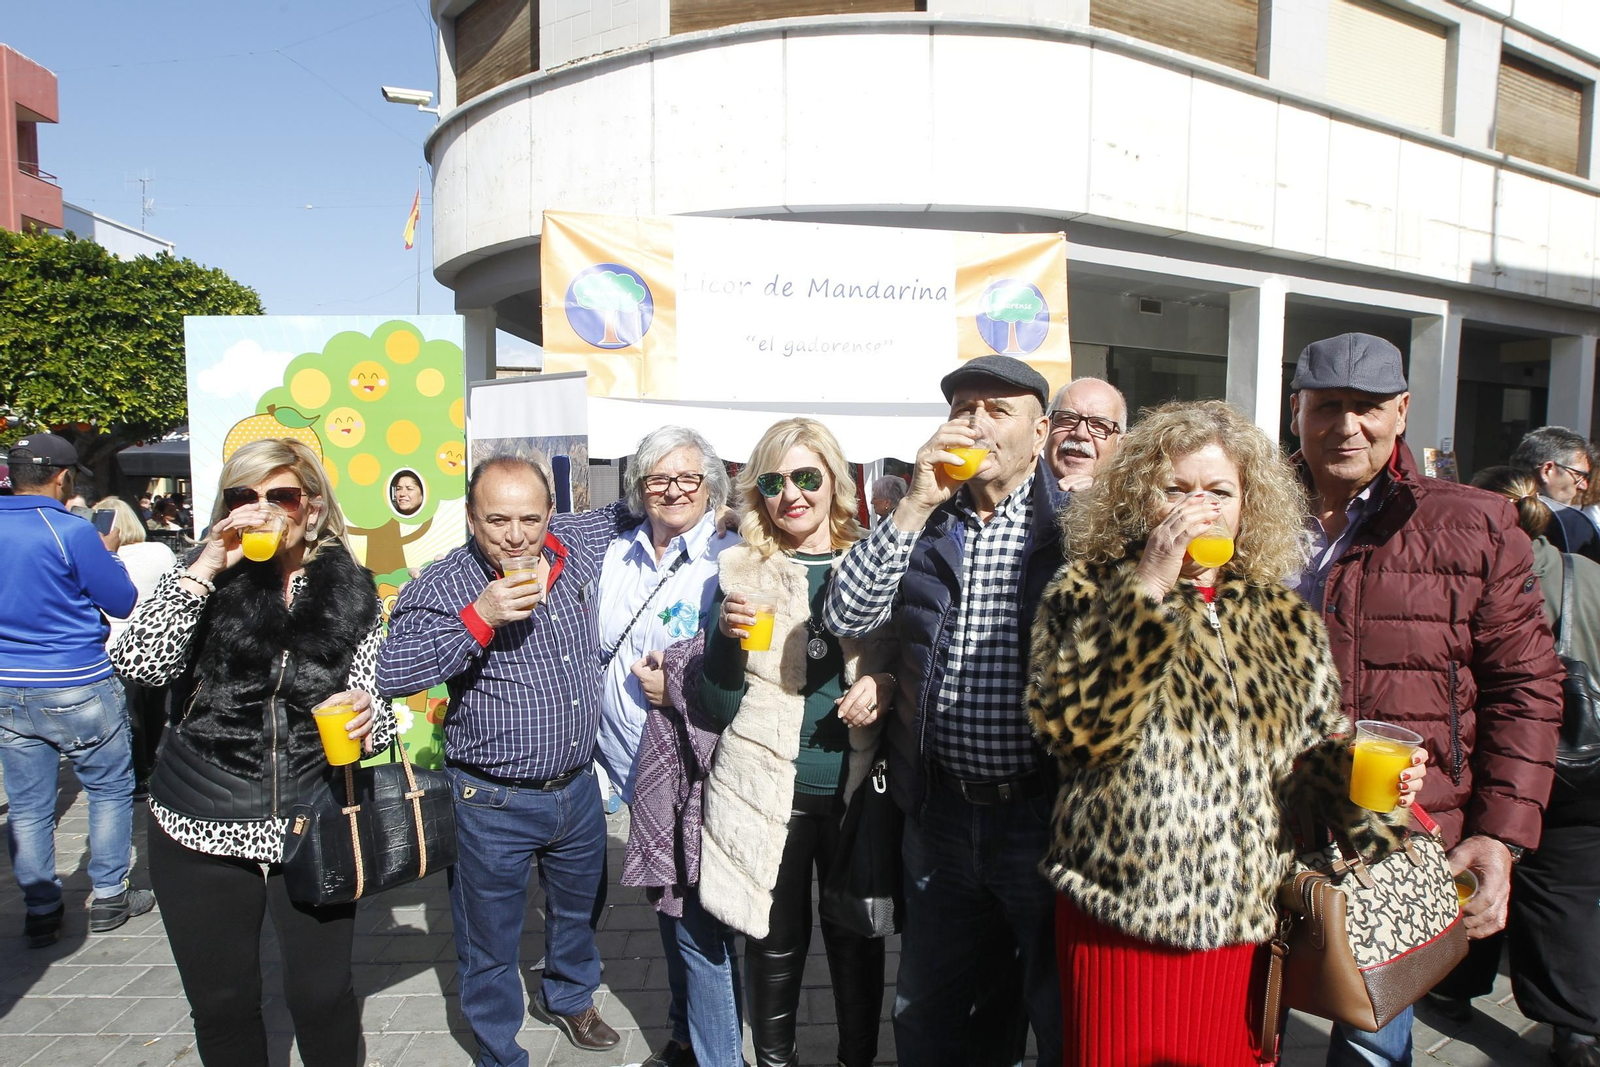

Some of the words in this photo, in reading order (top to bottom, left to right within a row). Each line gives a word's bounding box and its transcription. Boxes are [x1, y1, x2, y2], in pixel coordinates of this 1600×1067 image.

[682, 272, 752, 295] Licor
[764, 273, 794, 297] de
[807, 278, 948, 301] Mandarina
